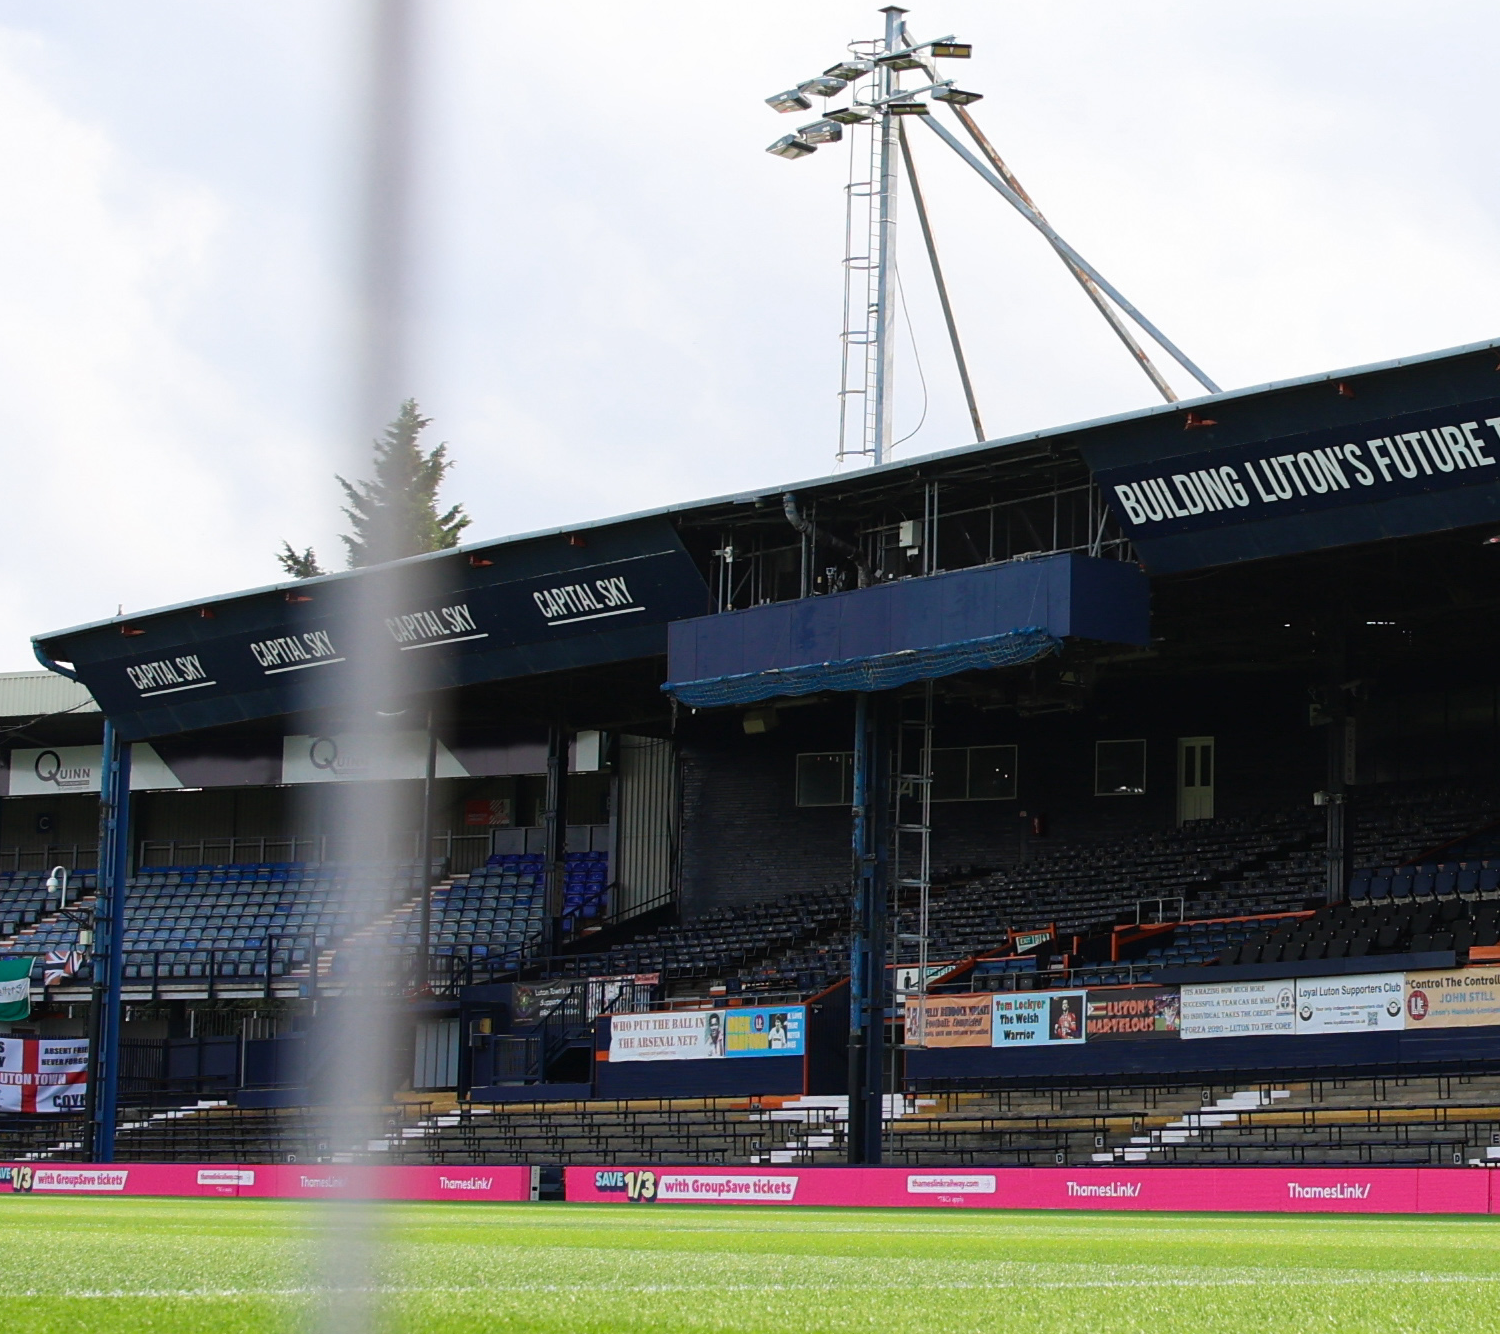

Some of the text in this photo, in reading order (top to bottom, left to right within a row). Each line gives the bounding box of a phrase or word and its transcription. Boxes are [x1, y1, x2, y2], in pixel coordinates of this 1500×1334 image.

[1113, 464, 1251, 527] BUILDING
[1244, 442, 1375, 503] LUTON'S
[1366, 421, 1496, 484] FUTURE
[533, 576, 633, 618] CAPITAL SKY
[385, 604, 477, 643] CAPITAL SKY
[250, 629, 336, 667] CAPITAL SKY
[126, 654, 206, 690] CAPITAL SKY
[35, 750, 91, 786] QUINN
[1299, 982, 1401, 999] Loyal Luton Supporters Club
[1445, 977, 1462, 988] The
[996, 999, 1046, 1012] Tom Lockyer
[1439, 992, 1495, 1003] JOHN STILL
[1107, 999, 1155, 1016] LUTON'S
[612, 1017, 706, 1031] WHO PUT THE BALL IN
[1000, 1012, 1039, 1025] The Welsh
[1087, 1016, 1155, 1033] MARVELOUS
[618, 1035, 698, 1049] THE ARSENAL NET?
[1003, 1029, 1035, 1041] Warrior
[34, 1073, 67, 1085] TOWN
[595, 1171, 656, 1198] SAVE 1/3
[665, 1178, 792, 1196] with GroupSave tickets
